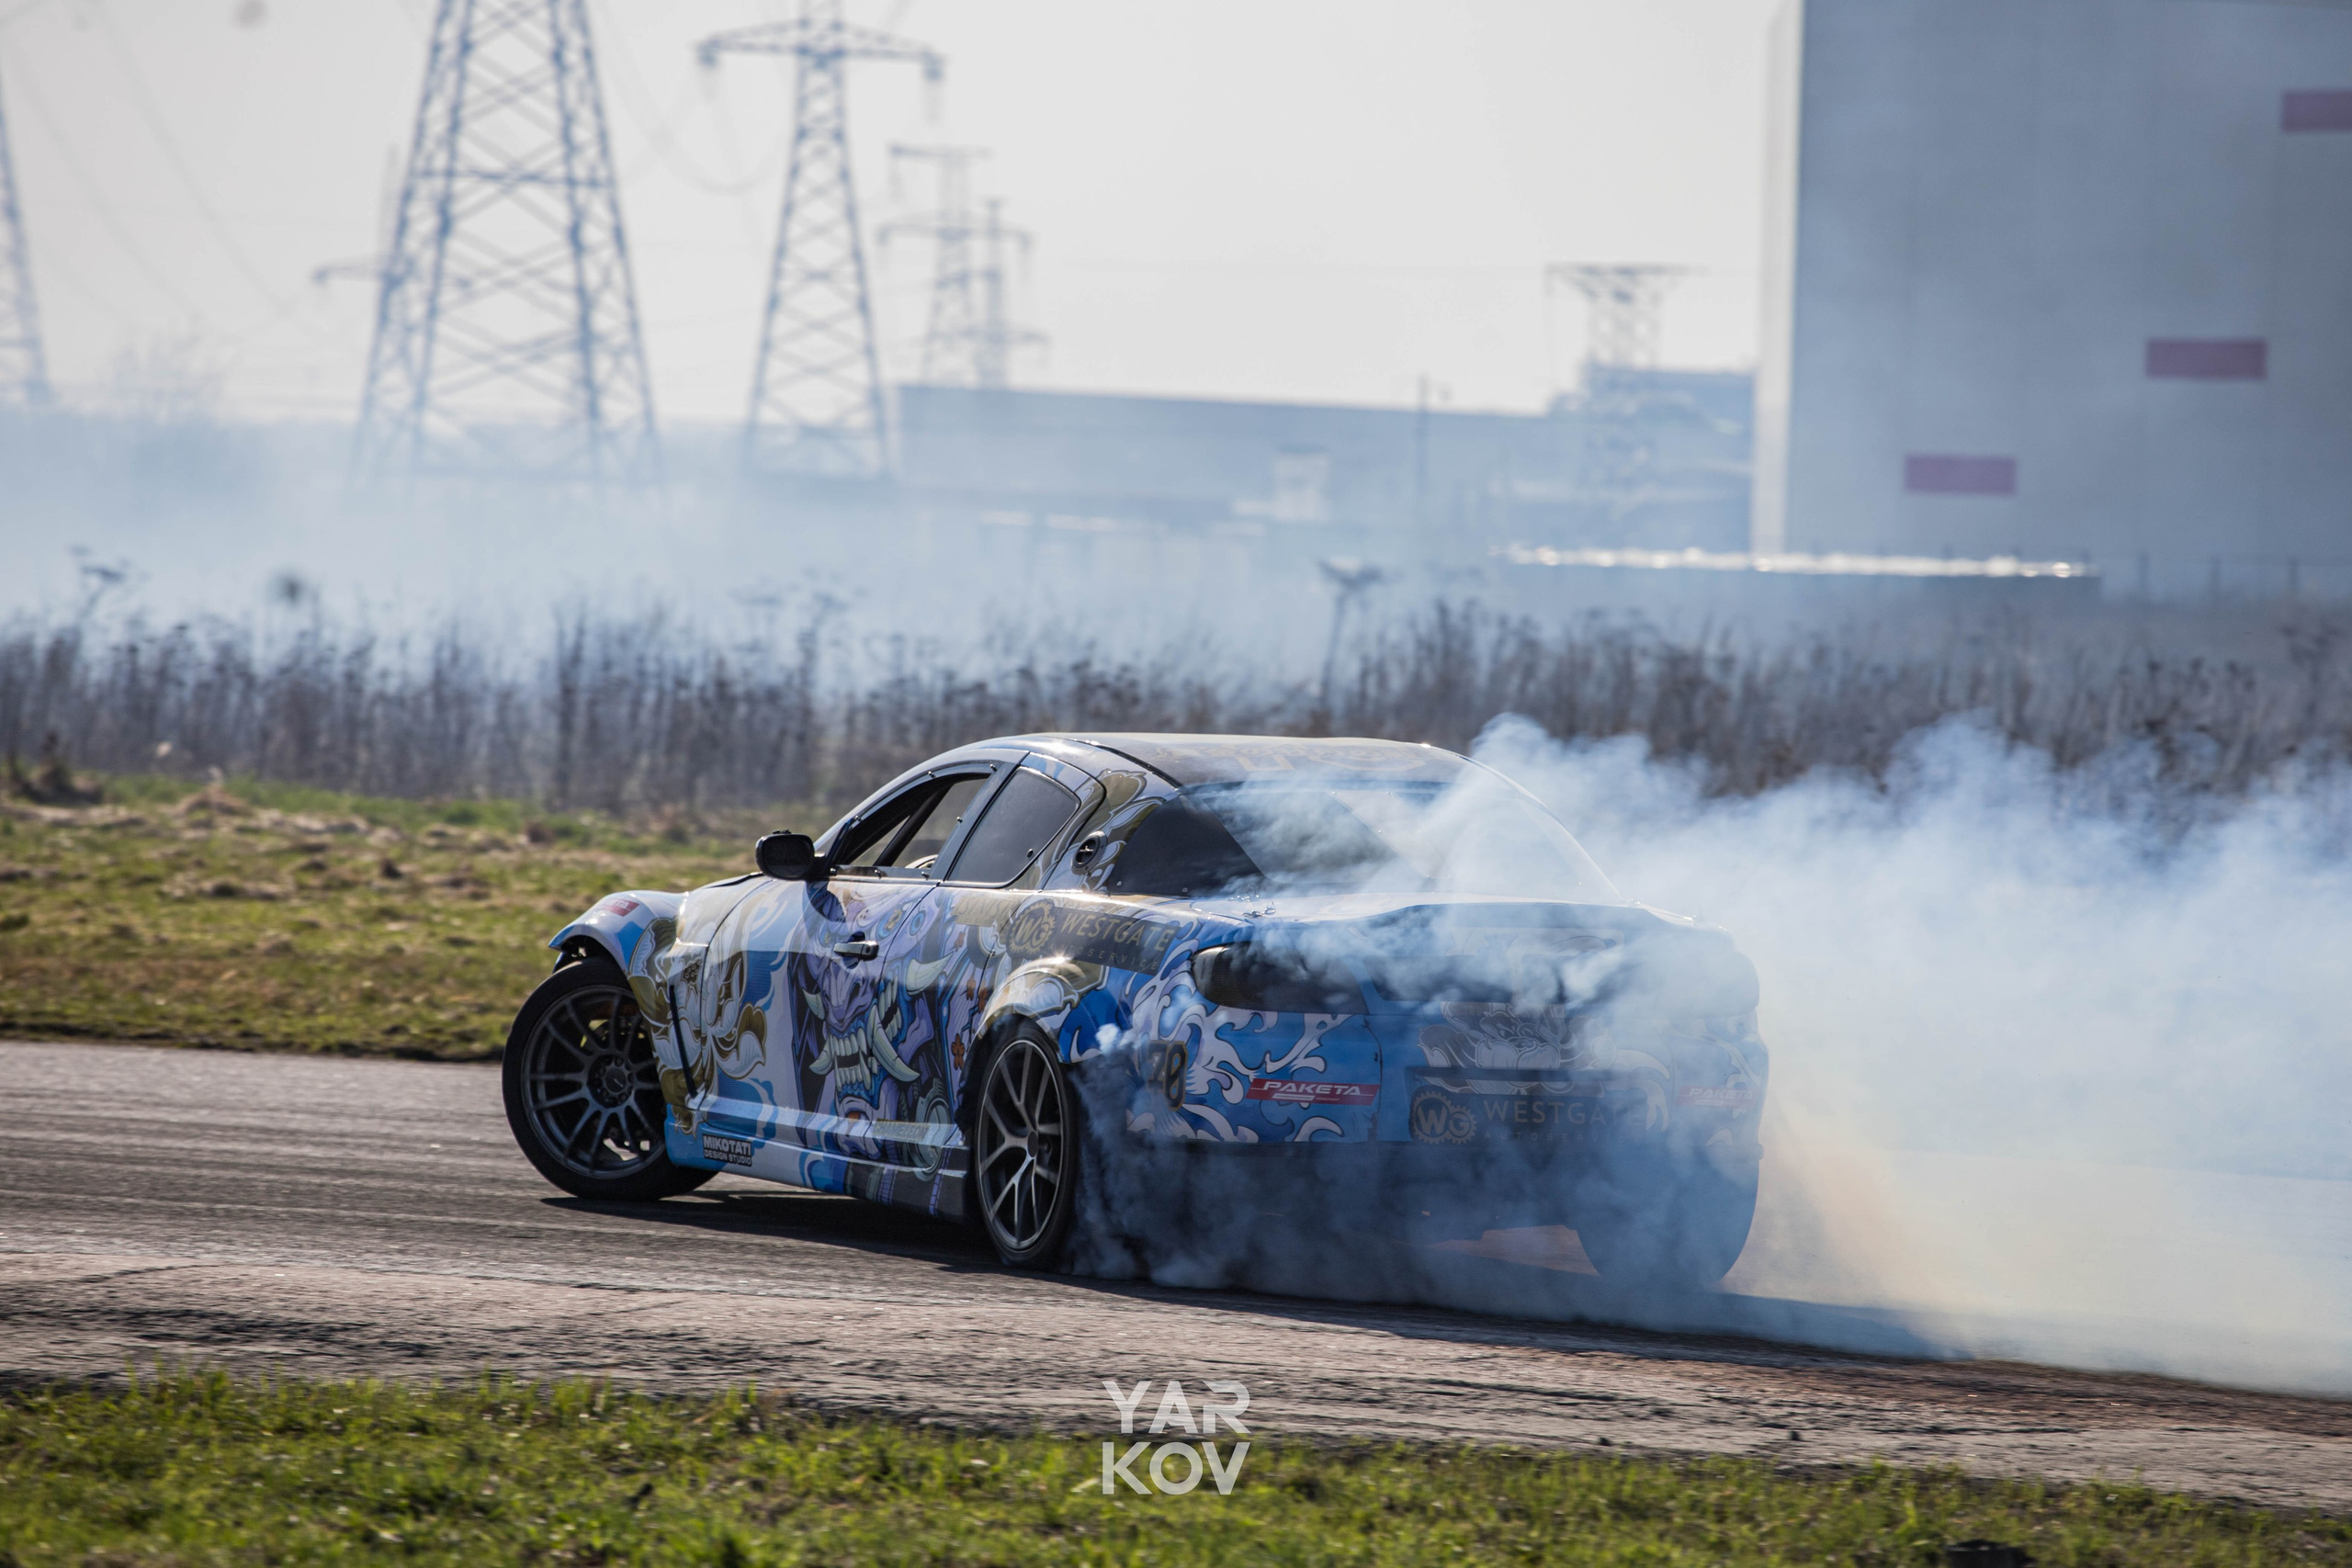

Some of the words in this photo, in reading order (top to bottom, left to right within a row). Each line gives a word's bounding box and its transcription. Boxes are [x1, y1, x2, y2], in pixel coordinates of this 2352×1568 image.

[1060, 912, 1175, 952] WESTGATE
[1049, 943, 1160, 970] AUTOSERVICE
[703, 1135, 752, 1156] MIKOTATI
[704, 1149, 728, 1161] DESIGN
[729, 1153, 752, 1165] STUDIO
